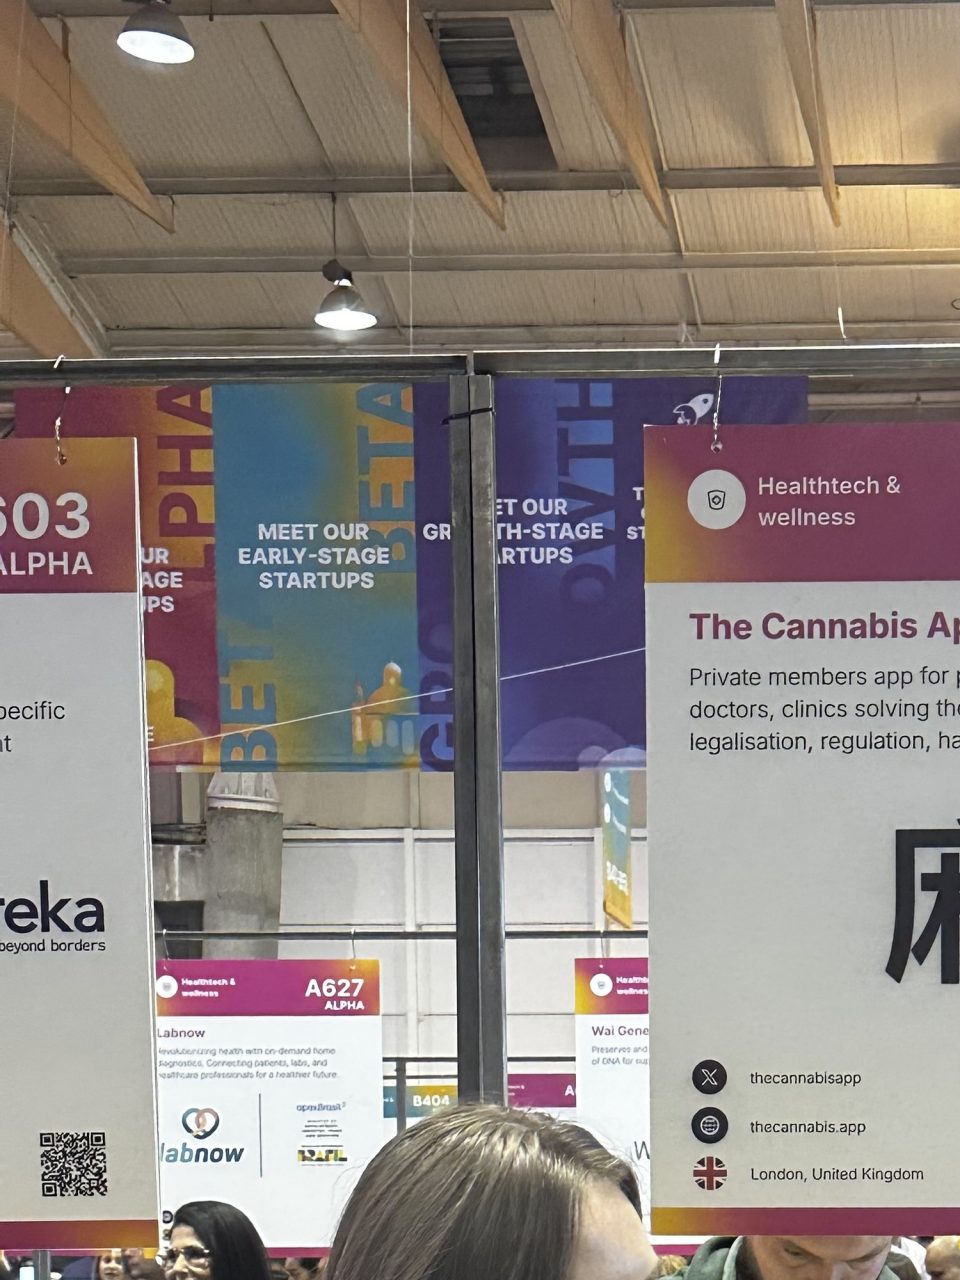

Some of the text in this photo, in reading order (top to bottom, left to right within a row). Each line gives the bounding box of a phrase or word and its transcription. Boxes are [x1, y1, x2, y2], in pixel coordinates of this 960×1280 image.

[758, 475, 901, 495] Healthtech &
[0, 491, 90, 540] 03
[522, 498, 568, 516] OUR
[758, 507, 856, 526] wellness
[258, 522, 369, 541] MEET OUR
[238, 547, 390, 565] EARLY-STAGE
[258, 571, 375, 590] STARTUPS
[689, 613, 752, 640] The
[761, 610, 918, 640] Cannabis
[690, 667, 762, 686] Private
[768, 667, 868, 686] members
[874, 670, 913, 690] app
[919, 666, 950, 685] for
[689, 700, 775, 721] doctors,
[781, 700, 848, 719] clinics
[854, 699, 929, 722] solving
[689, 732, 813, 755] legalisation,
[820, 731, 931, 754] regulation,
[50, 938, 106, 952] borders
[305, 978, 365, 998] A627
[324, 1000, 365, 1011] ALPHA
[750, 1071, 862, 1087] thecannabisapp
[413, 1094, 451, 1107] B404
[750, 1121, 867, 1136] thecannabis.app
[161, 1142, 245, 1163] labnow
[750, 1167, 924, 1183] London, United Kingdom
